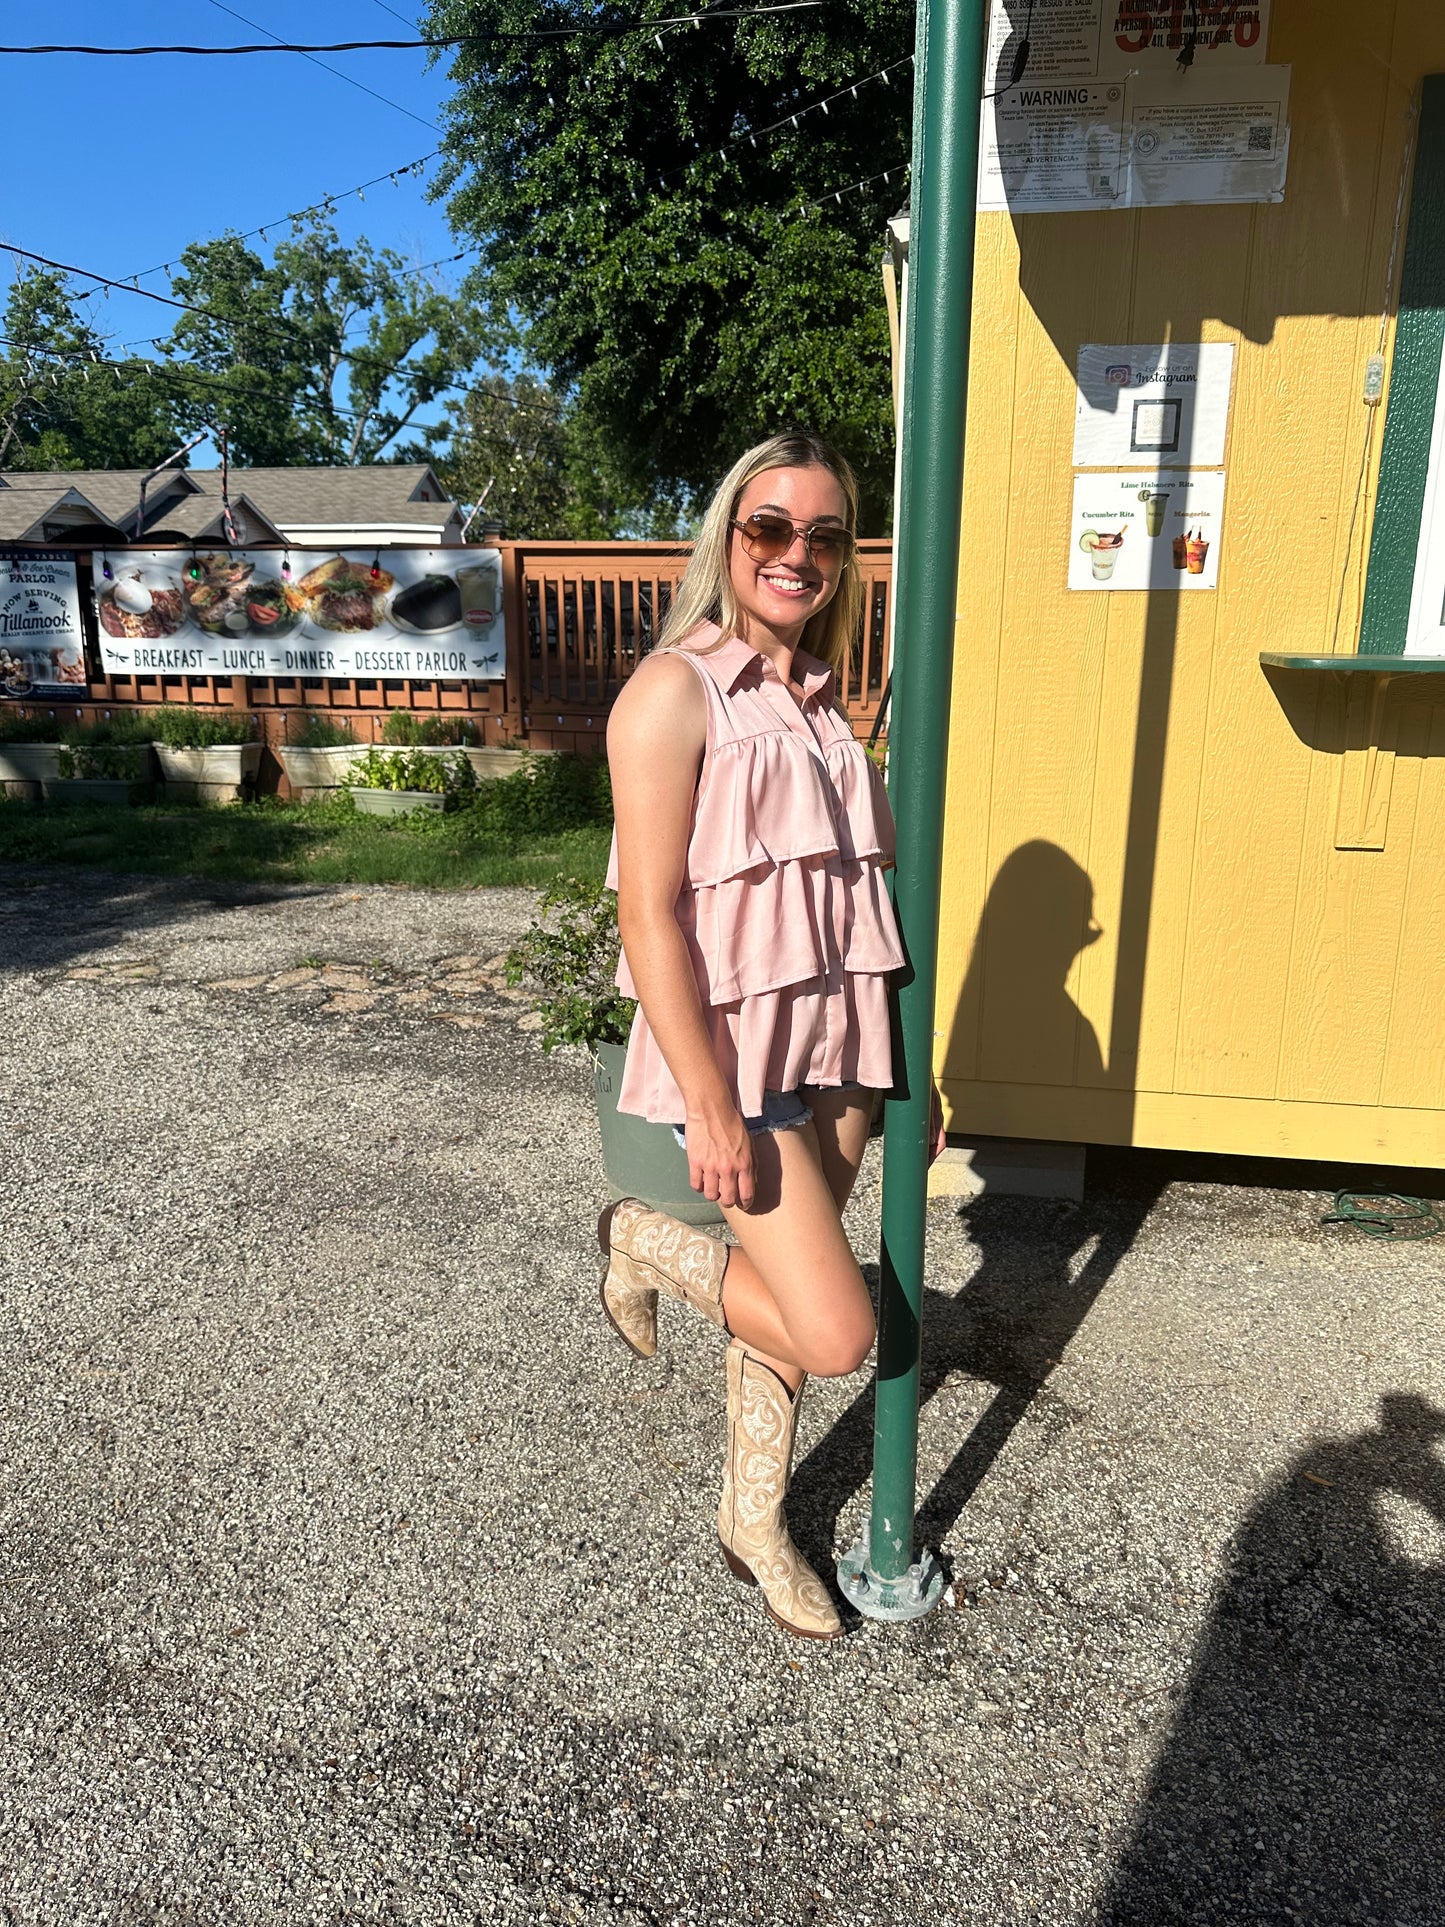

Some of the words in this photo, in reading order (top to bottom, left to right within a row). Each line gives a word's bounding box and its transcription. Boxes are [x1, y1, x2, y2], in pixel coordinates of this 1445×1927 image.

[1020, 89, 1088, 106] WARNING
[1026, 155, 1075, 164] ADVERTENCIA
[1136, 372, 1198, 387] Instagram
[9, 574, 56, 584] PARLOR
[3, 593, 21, 613] NOW
[25, 589, 67, 607] SERVING
[0, 610, 71, 632] Tillamook
[134, 649, 203, 668] BREAKFAST
[223, 650, 265, 669] LUNCH
[286, 651, 335, 670] DINNER
[355, 651, 411, 670] DESSERT
[417, 652, 467, 671] PARLOR
